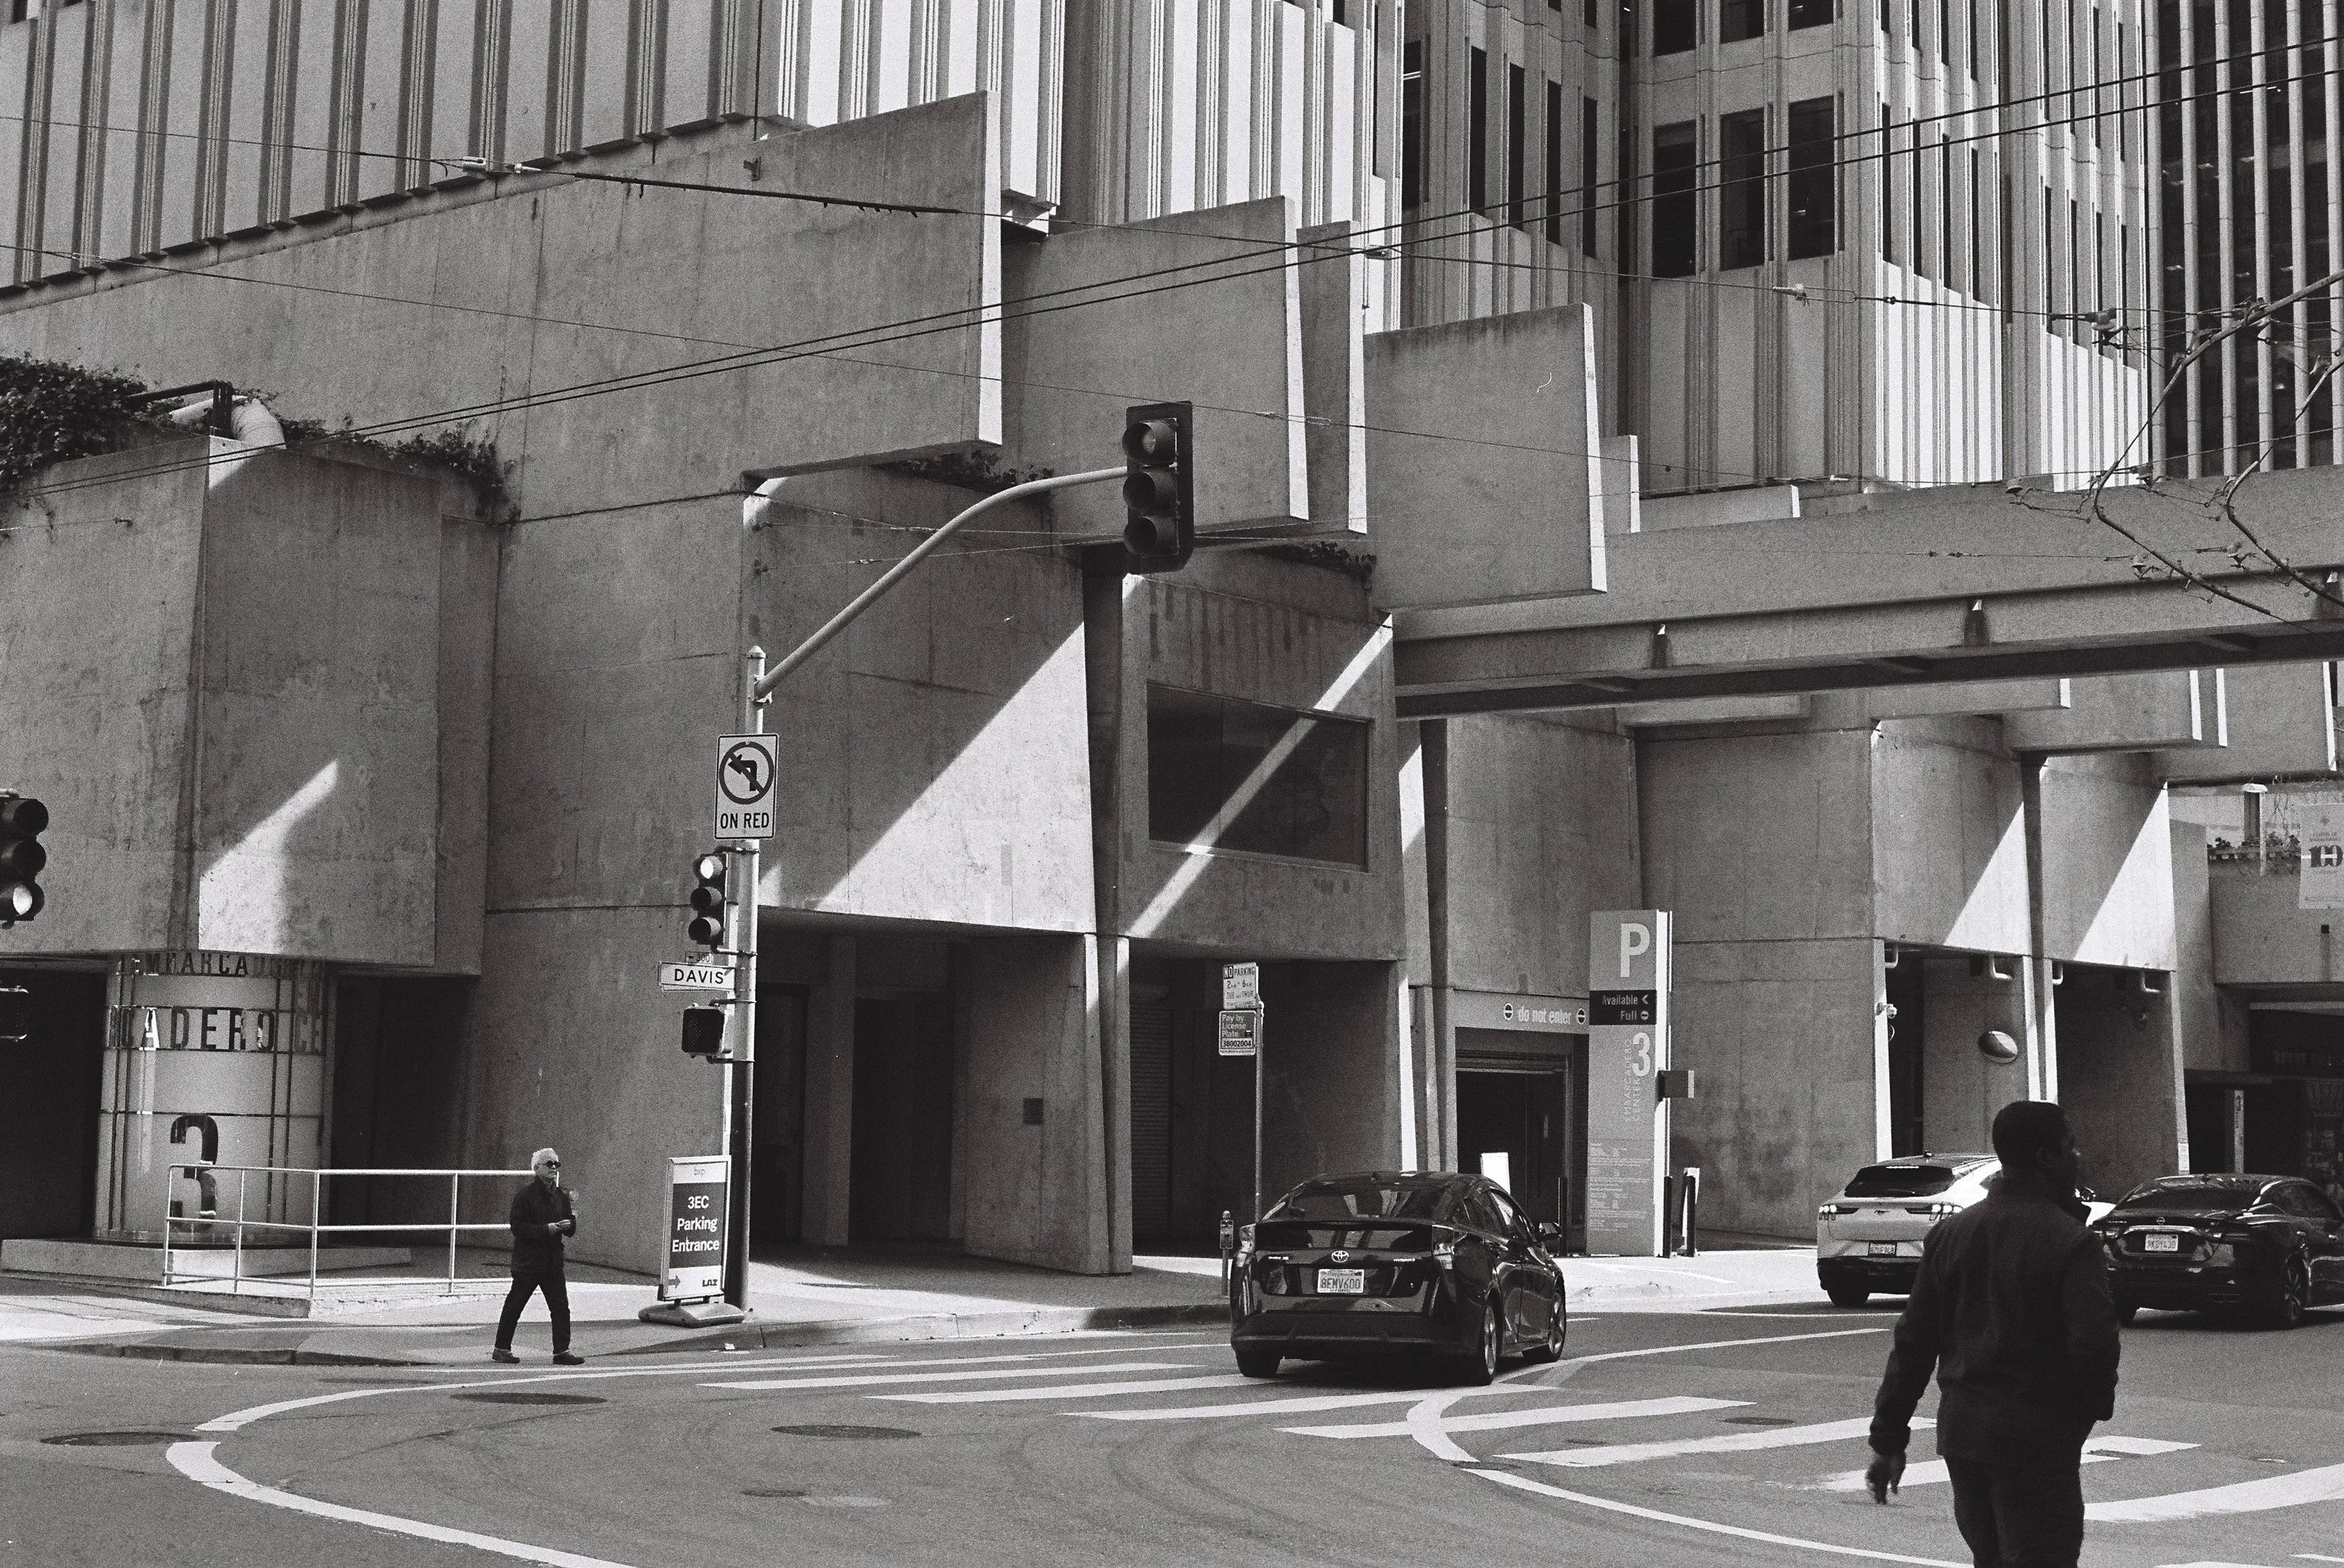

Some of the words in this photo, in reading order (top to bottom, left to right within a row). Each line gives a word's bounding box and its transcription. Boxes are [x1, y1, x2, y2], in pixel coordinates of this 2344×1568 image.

[720, 812, 738, 829] ON
[743, 812, 769, 829] RED
[696, 953, 711, 963] 300
[1620, 923, 1650, 978] P
[674, 968, 724, 985] DAVIS
[1224, 966, 1233, 978] NO
[1234, 967, 1255, 976] PARKING
[1602, 995, 1638, 1006] Available
[1222, 1014, 1234, 1023] Pay
[1235, 1014, 1244, 1023] by
[1517, 1006, 1529, 1022] do
[1532, 1008, 1547, 1023] not
[1549, 1010, 1571, 1025] enter
[1620, 1010, 1637, 1021] Full
[1633, 1032, 1651, 1077] 3
[169, 1114, 219, 1233] 3
[687, 1195, 710, 1210] 3EC
[677, 1216, 718, 1232] Parking
[672, 1237, 720, 1253] Entrance
[702, 1278, 718, 1287] LAZ
[1321, 1278, 1360, 1289] 8EMV600
